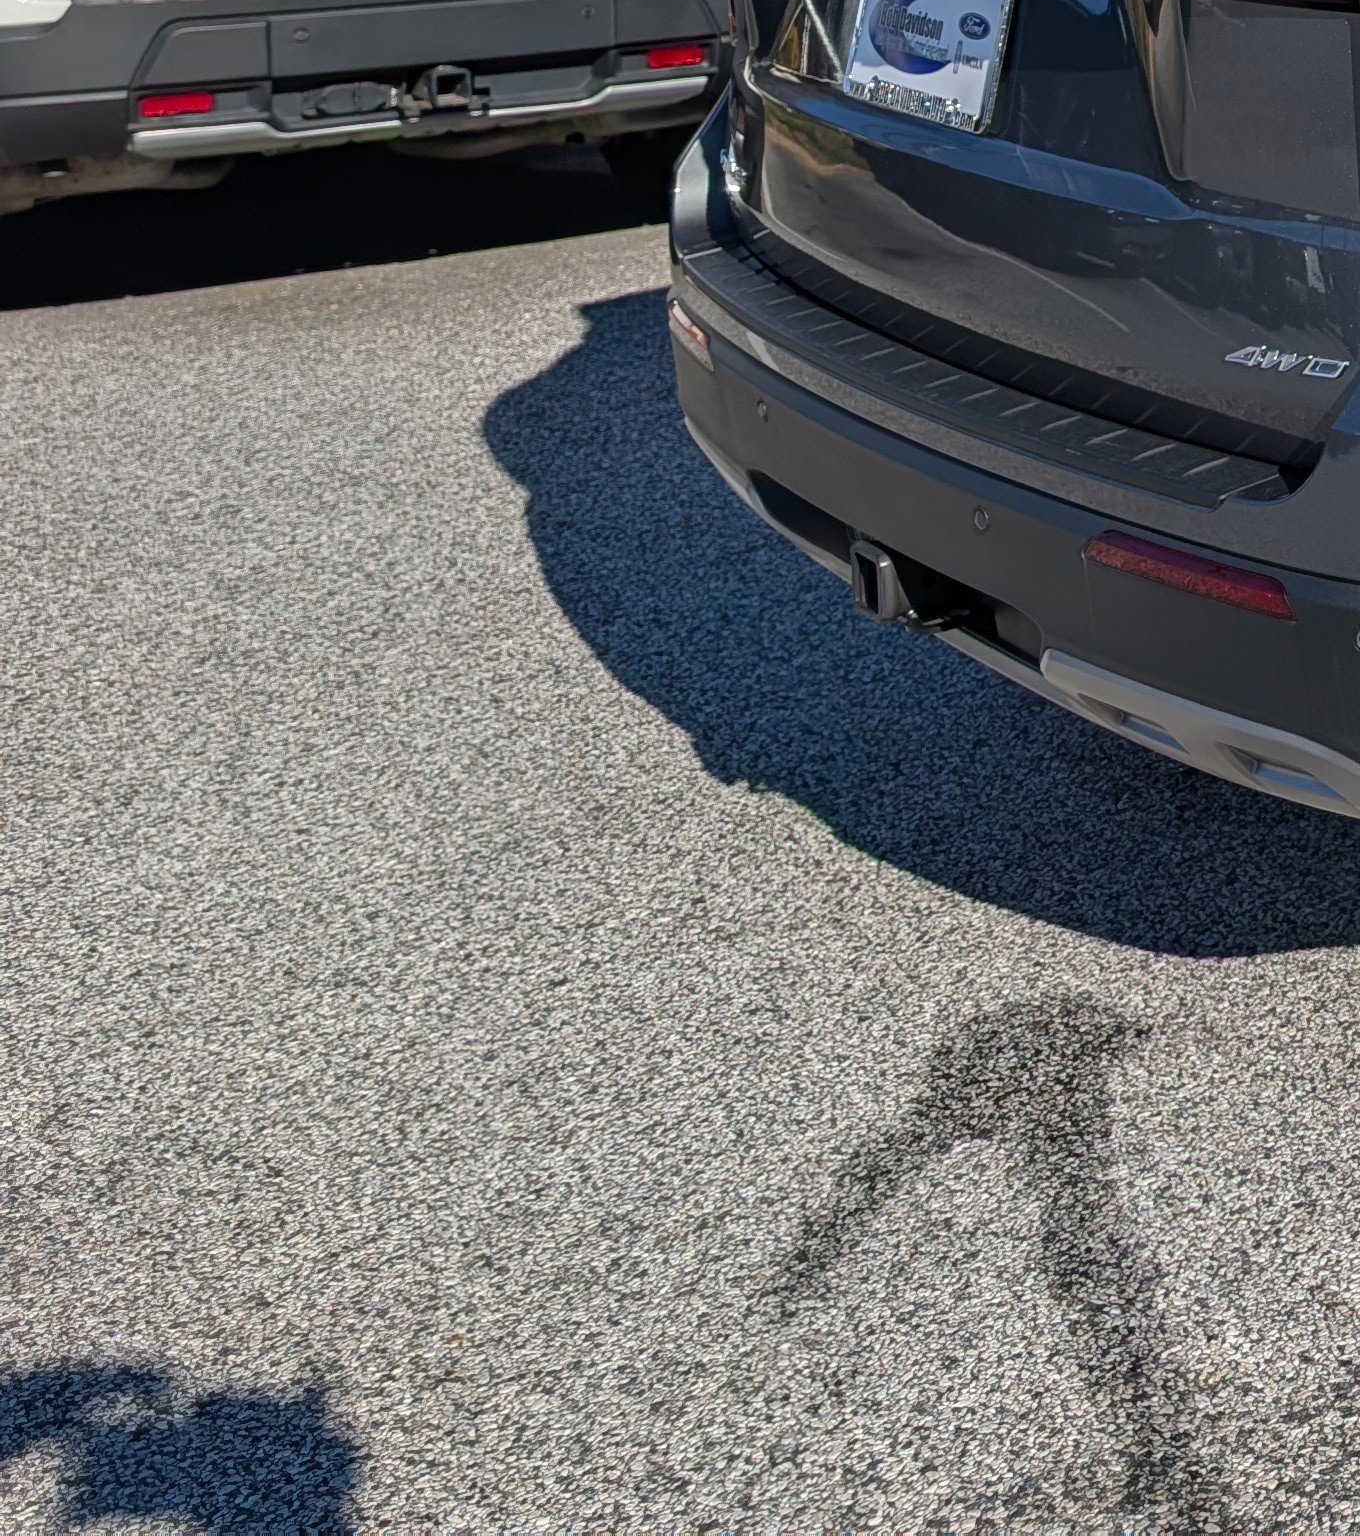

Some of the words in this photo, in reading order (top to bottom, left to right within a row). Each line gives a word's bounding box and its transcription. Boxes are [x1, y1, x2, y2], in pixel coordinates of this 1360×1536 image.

[881, 2, 899, 28] Bob
[900, 6, 944, 41] Davidson
[963, 15, 985, 36] Ford
[1224, 345, 1350, 379] 4WD
